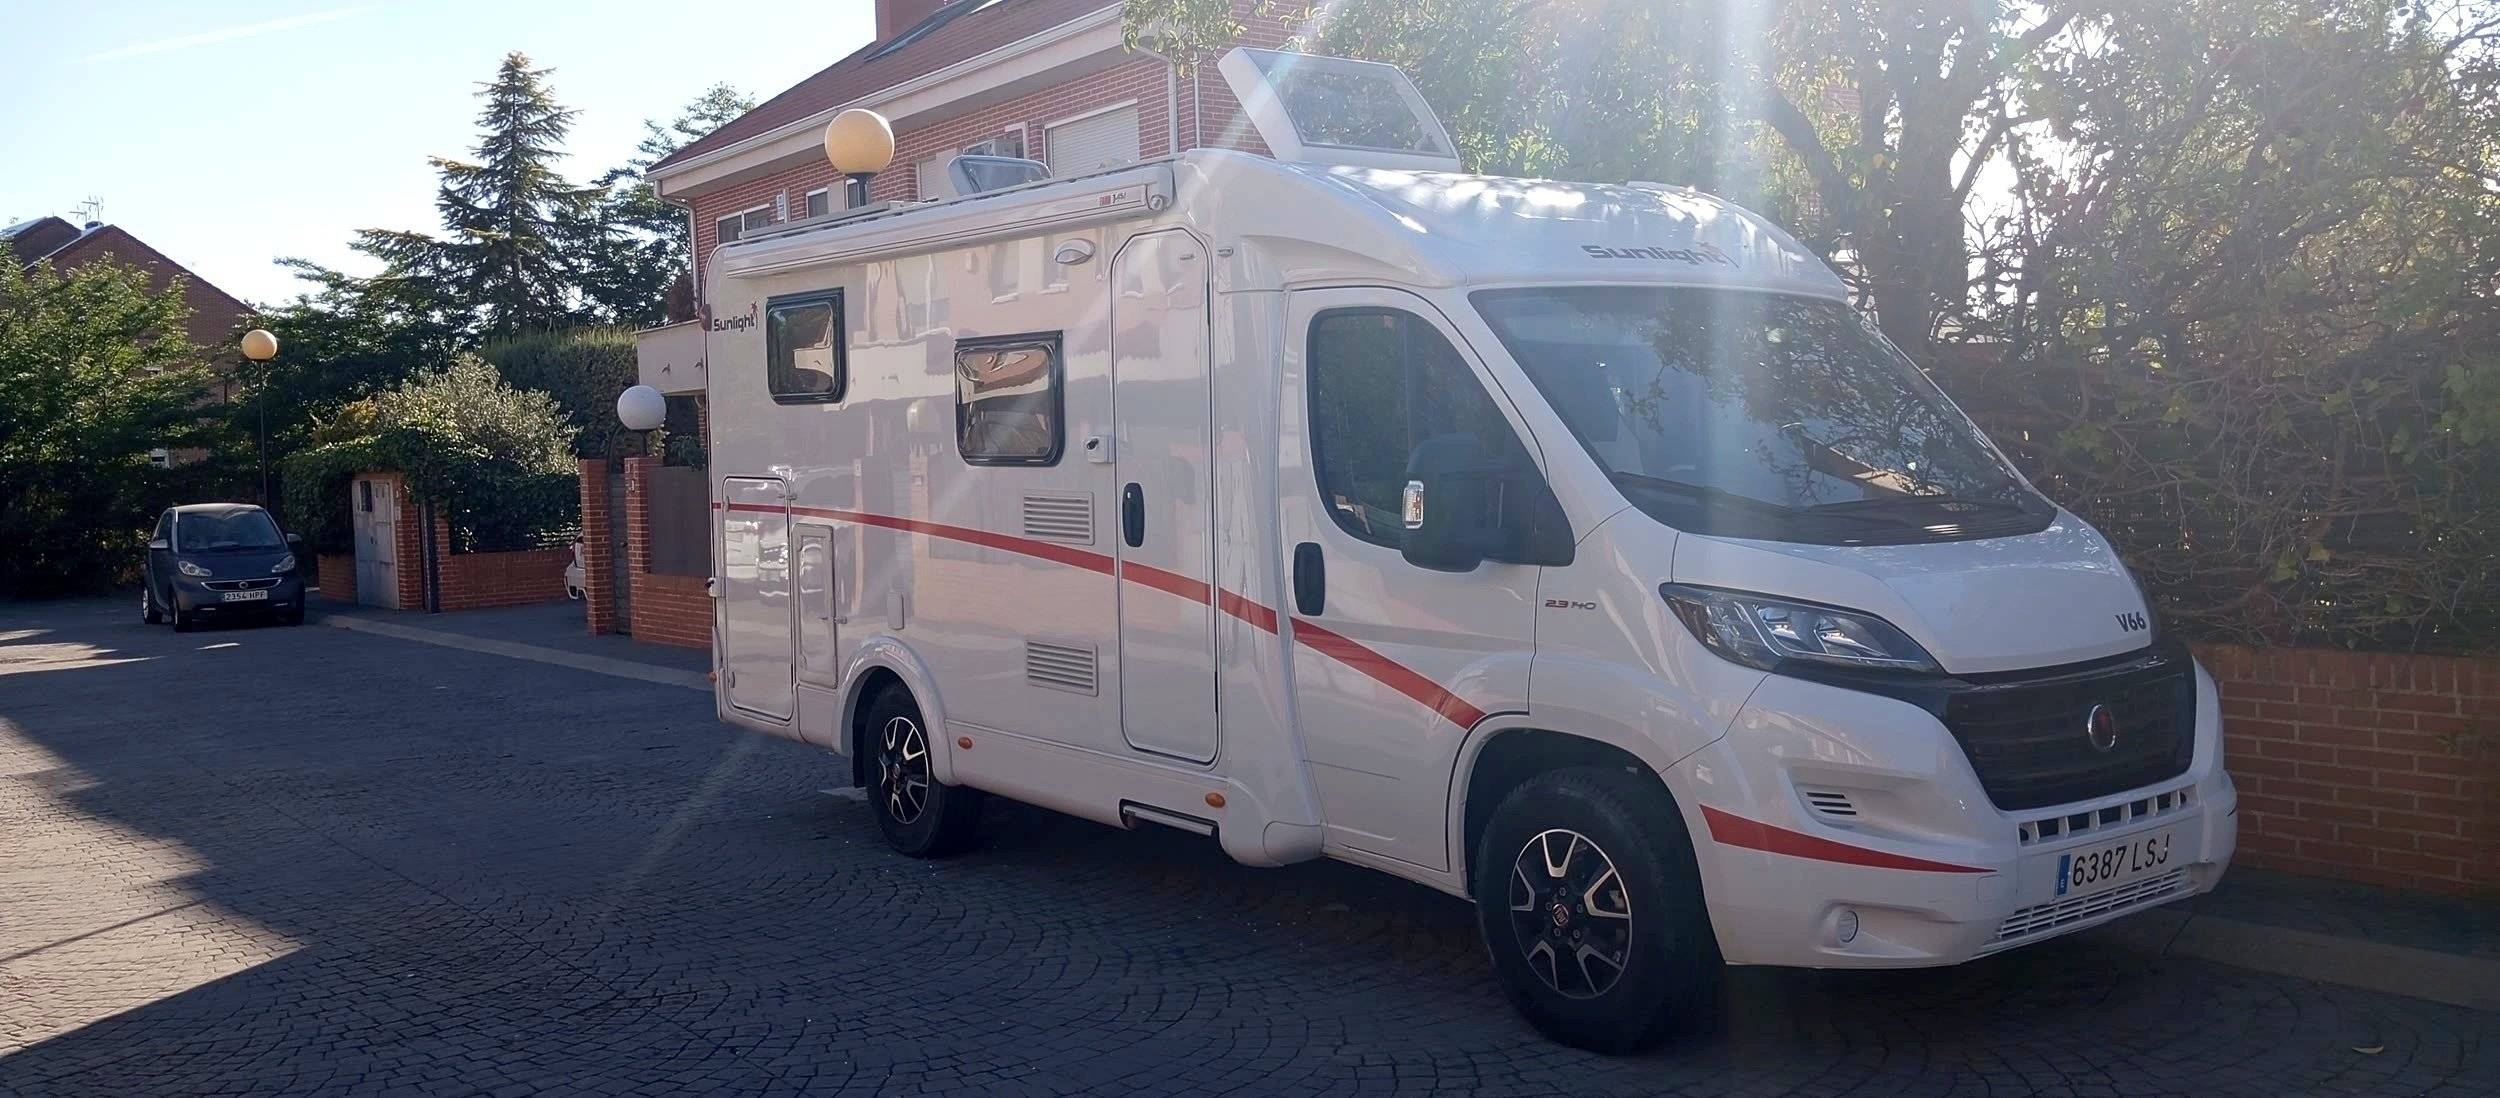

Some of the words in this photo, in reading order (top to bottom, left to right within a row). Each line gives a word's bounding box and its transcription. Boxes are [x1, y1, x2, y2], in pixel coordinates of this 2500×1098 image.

[1581, 245, 1727, 265] Sunlight
[713, 314, 755, 333] Sunlight
[2114, 611, 2147, 633] V66
[2072, 845, 2128, 887] 6387
[2131, 833, 2170, 872] LSJ
